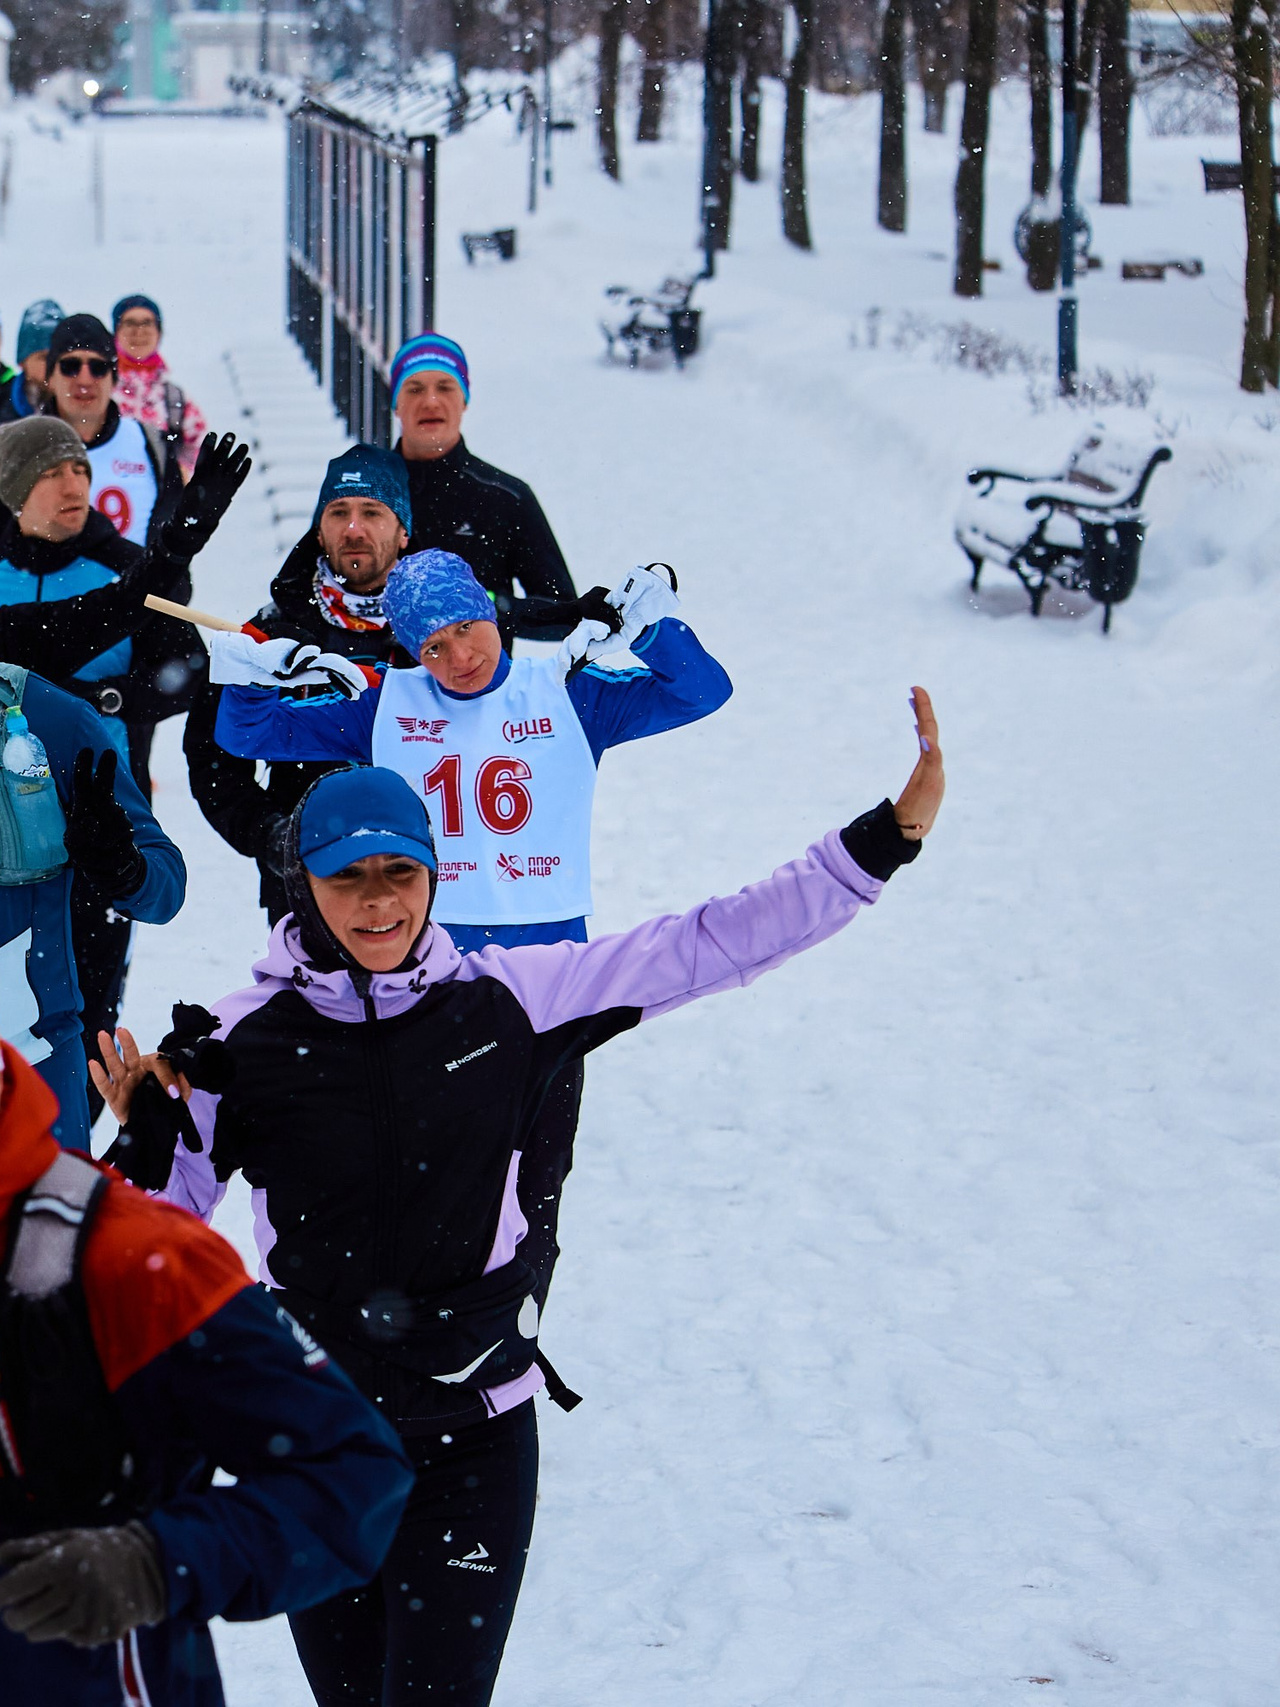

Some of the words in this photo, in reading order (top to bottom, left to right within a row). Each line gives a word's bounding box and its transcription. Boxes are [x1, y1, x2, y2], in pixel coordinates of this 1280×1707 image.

[510, 717, 553, 739] НЦВ
[423, 754, 532, 837] 16
[437, 862, 477, 871] ТОЛЕТЫ
[528, 856, 561, 866] ППОО
[437, 872, 459, 882] СИИ
[528, 867, 552, 877] НЦВ
[457, 1041, 498, 1065] NORDSKI
[447, 1559, 497, 1573] DEMIX
